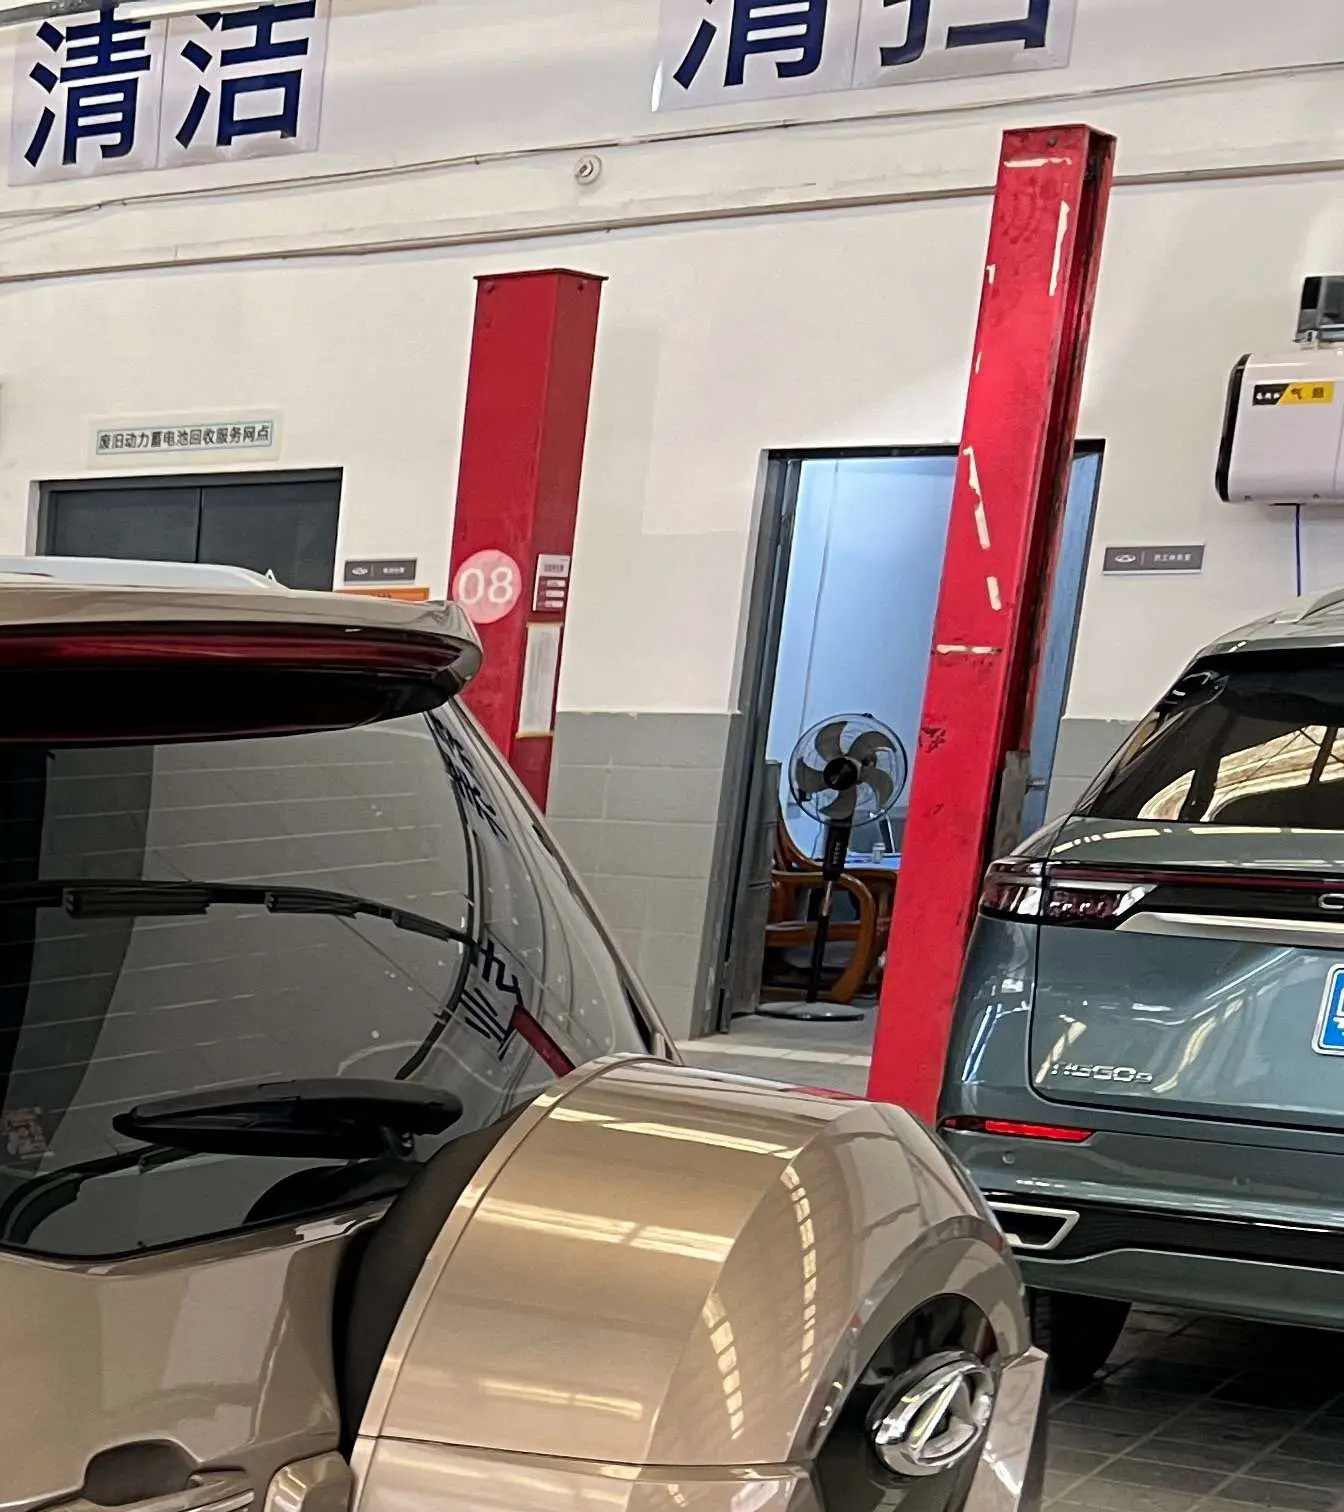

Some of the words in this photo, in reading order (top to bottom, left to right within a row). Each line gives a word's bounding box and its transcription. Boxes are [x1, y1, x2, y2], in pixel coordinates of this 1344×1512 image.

[24, 0, 315, 168] 清洁
[99, 425, 270, 450] 废旧动力蓄电池回收服务网点
[457, 565, 514, 605] 08
